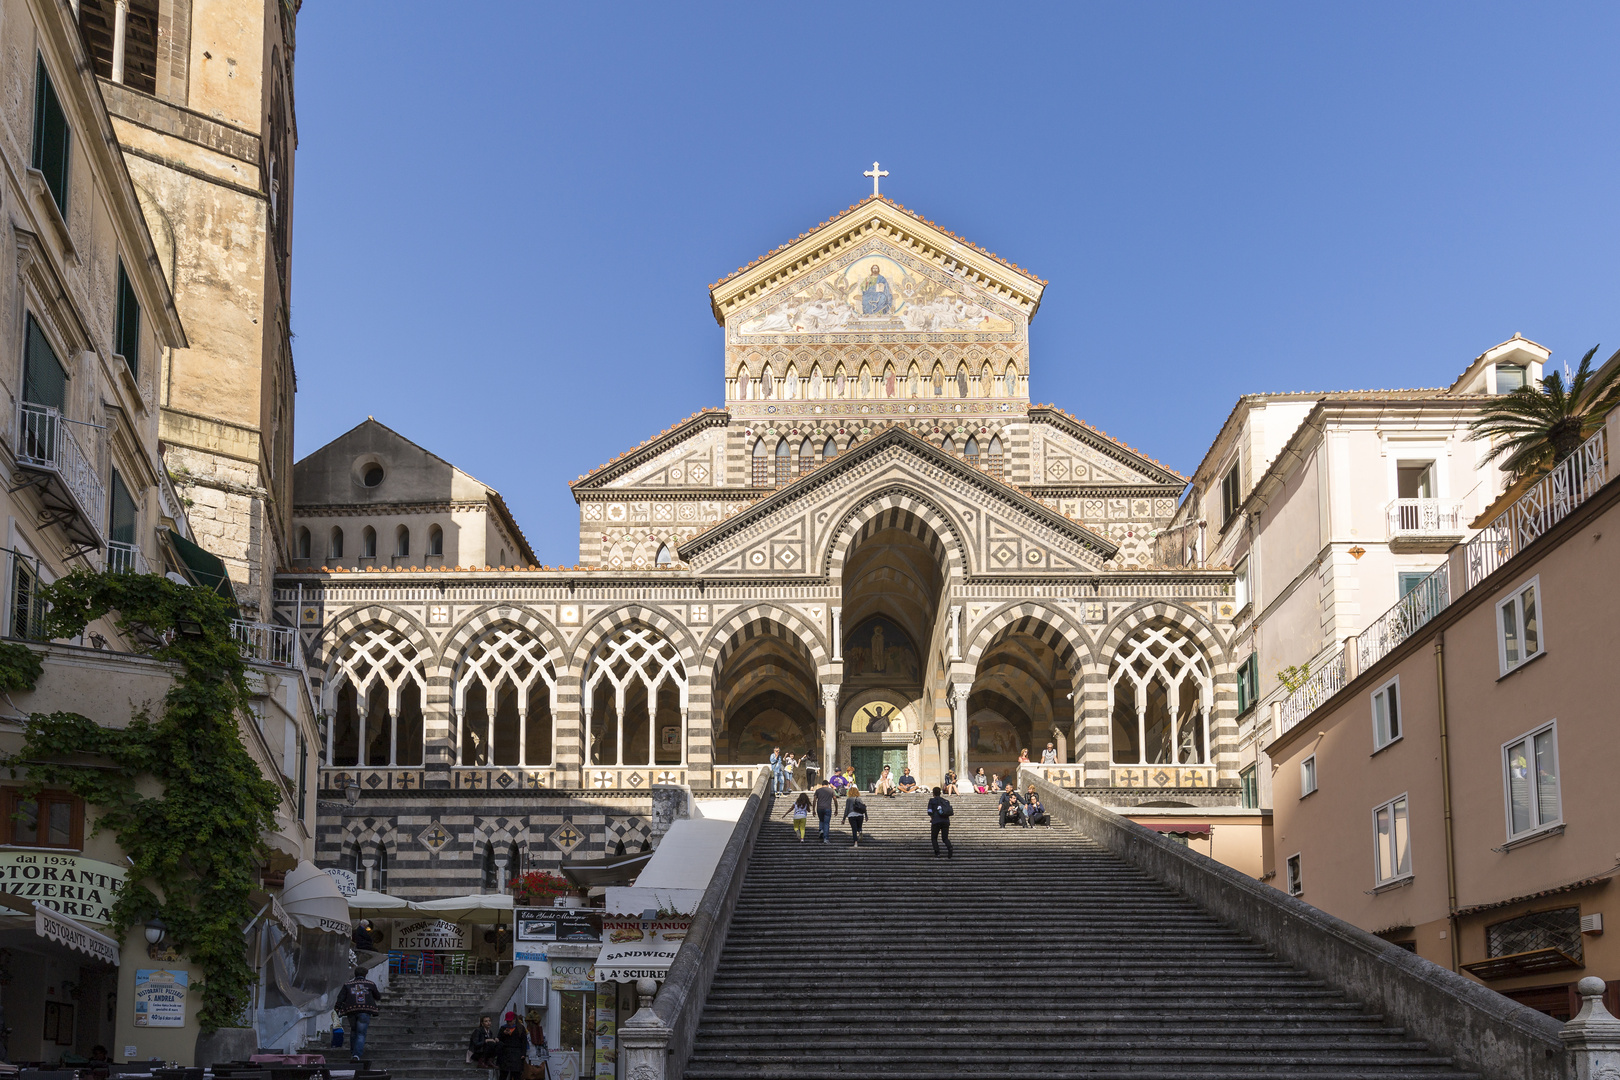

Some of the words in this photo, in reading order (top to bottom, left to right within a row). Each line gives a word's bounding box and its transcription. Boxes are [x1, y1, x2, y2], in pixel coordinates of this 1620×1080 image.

[16, 855, 37, 864] dal
[44, 856, 76, 867] 1934
[400, 921, 428, 936] TAVERNA
[436, 920, 465, 938] APOSTOLI
[603, 922, 640, 930] PANINI
[642, 922, 649, 930] E
[43, 917, 86, 948] RISTORANTE
[89, 938, 114, 959] PIZZERIA
[398, 937, 464, 948] RISTORANTE
[606, 951, 675, 960] SANDWICH
[609, 970, 621, 978] A'
[137, 988, 163, 998] RISTORANTE
[165, 988, 184, 999] PIZZERIA
